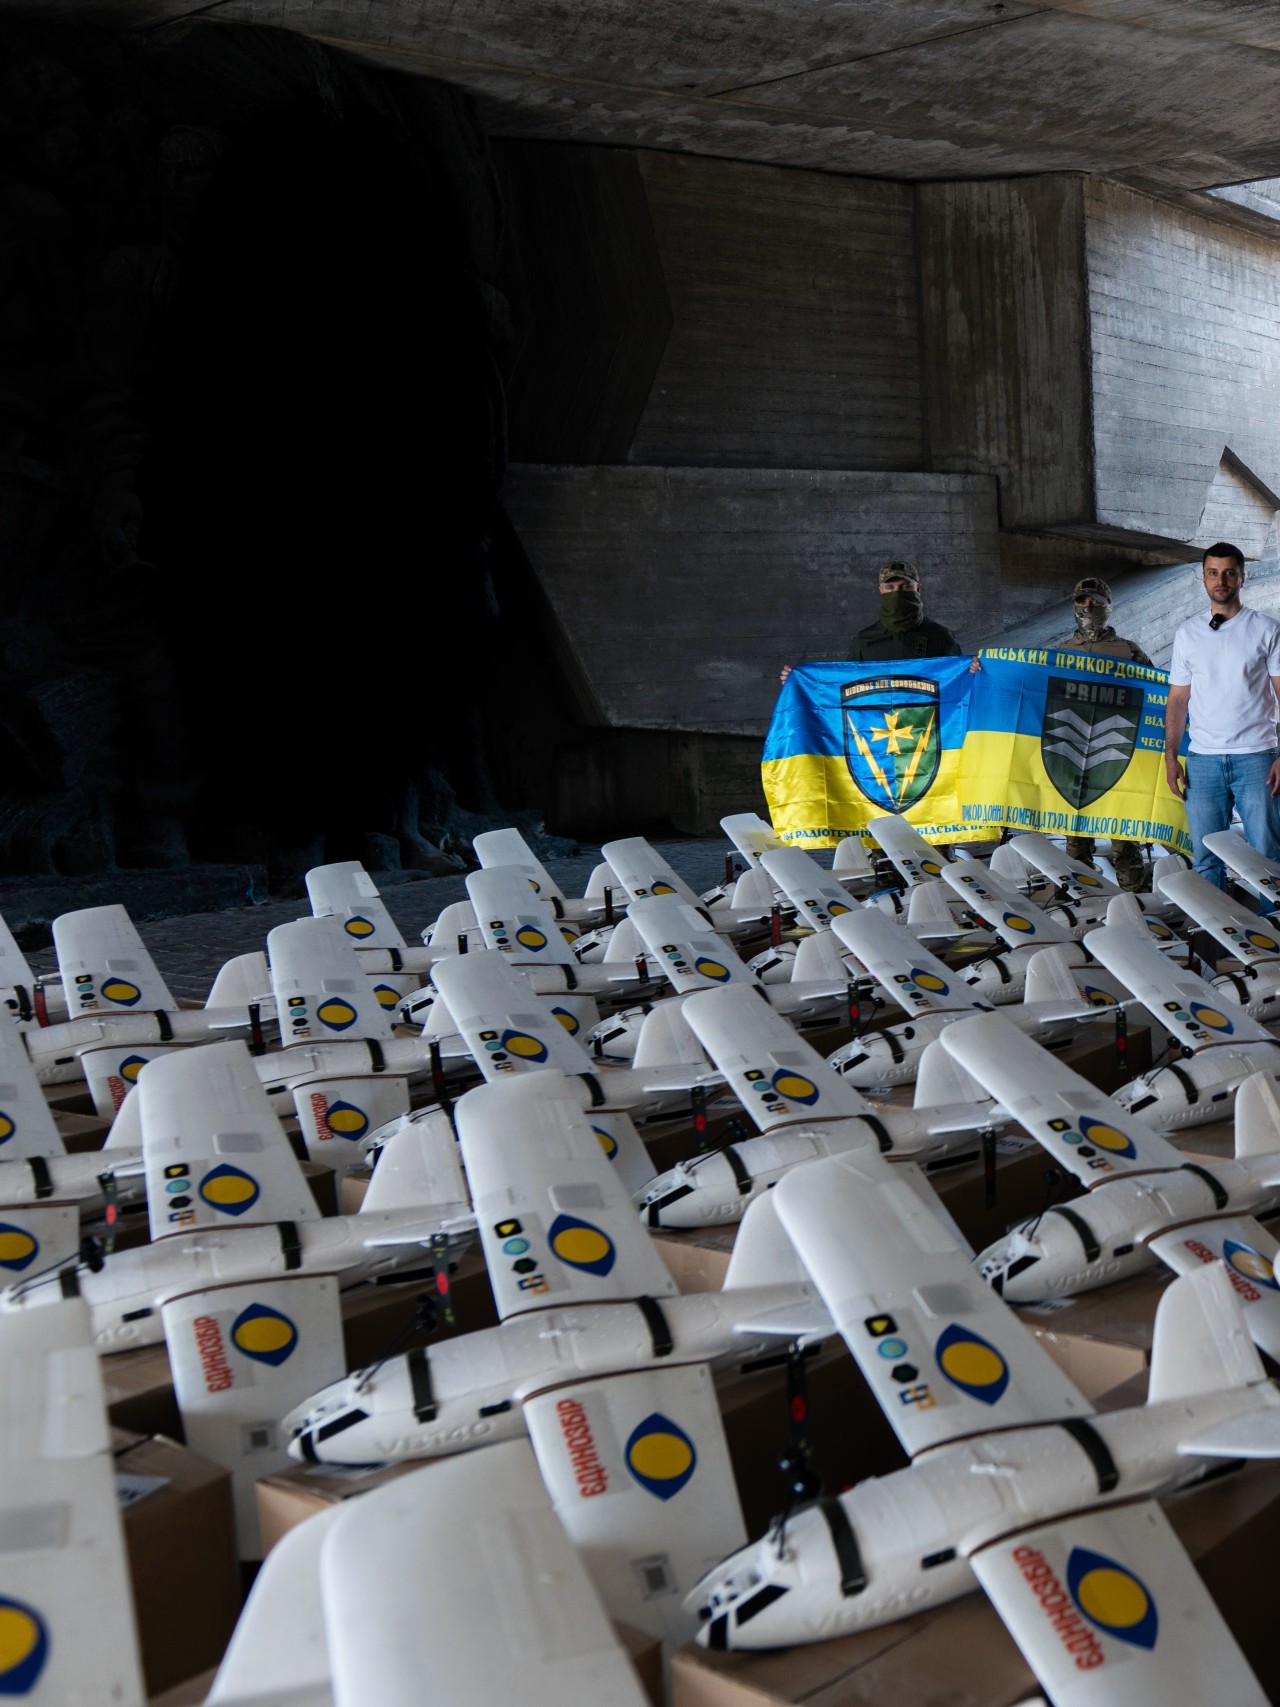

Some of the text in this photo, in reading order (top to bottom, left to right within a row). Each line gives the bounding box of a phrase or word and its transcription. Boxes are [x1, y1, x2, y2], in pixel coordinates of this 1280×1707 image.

[978, 648, 1170, 685] МСЬКИЙ ПРИКОРДОННИ
[1065, 682, 1127, 706] PRIME
[795, 827, 874, 839] РАДІОТЕХНІЧ
[916, 823, 968, 835] БІДСЬКА
[1006, 806, 1069, 830] КОМЕНДАТУРА
[1070, 815, 1118, 835] ШВИДКОГО
[1119, 819, 1174, 843] РЕАГУВАННЯ
[192, 1316, 235, 1394] ЄДИНОЗБІР
[555, 1397, 609, 1499] ЄДИНОЗБІР
[1010, 1544, 1106, 1673] ЄДИНОЗБІР
